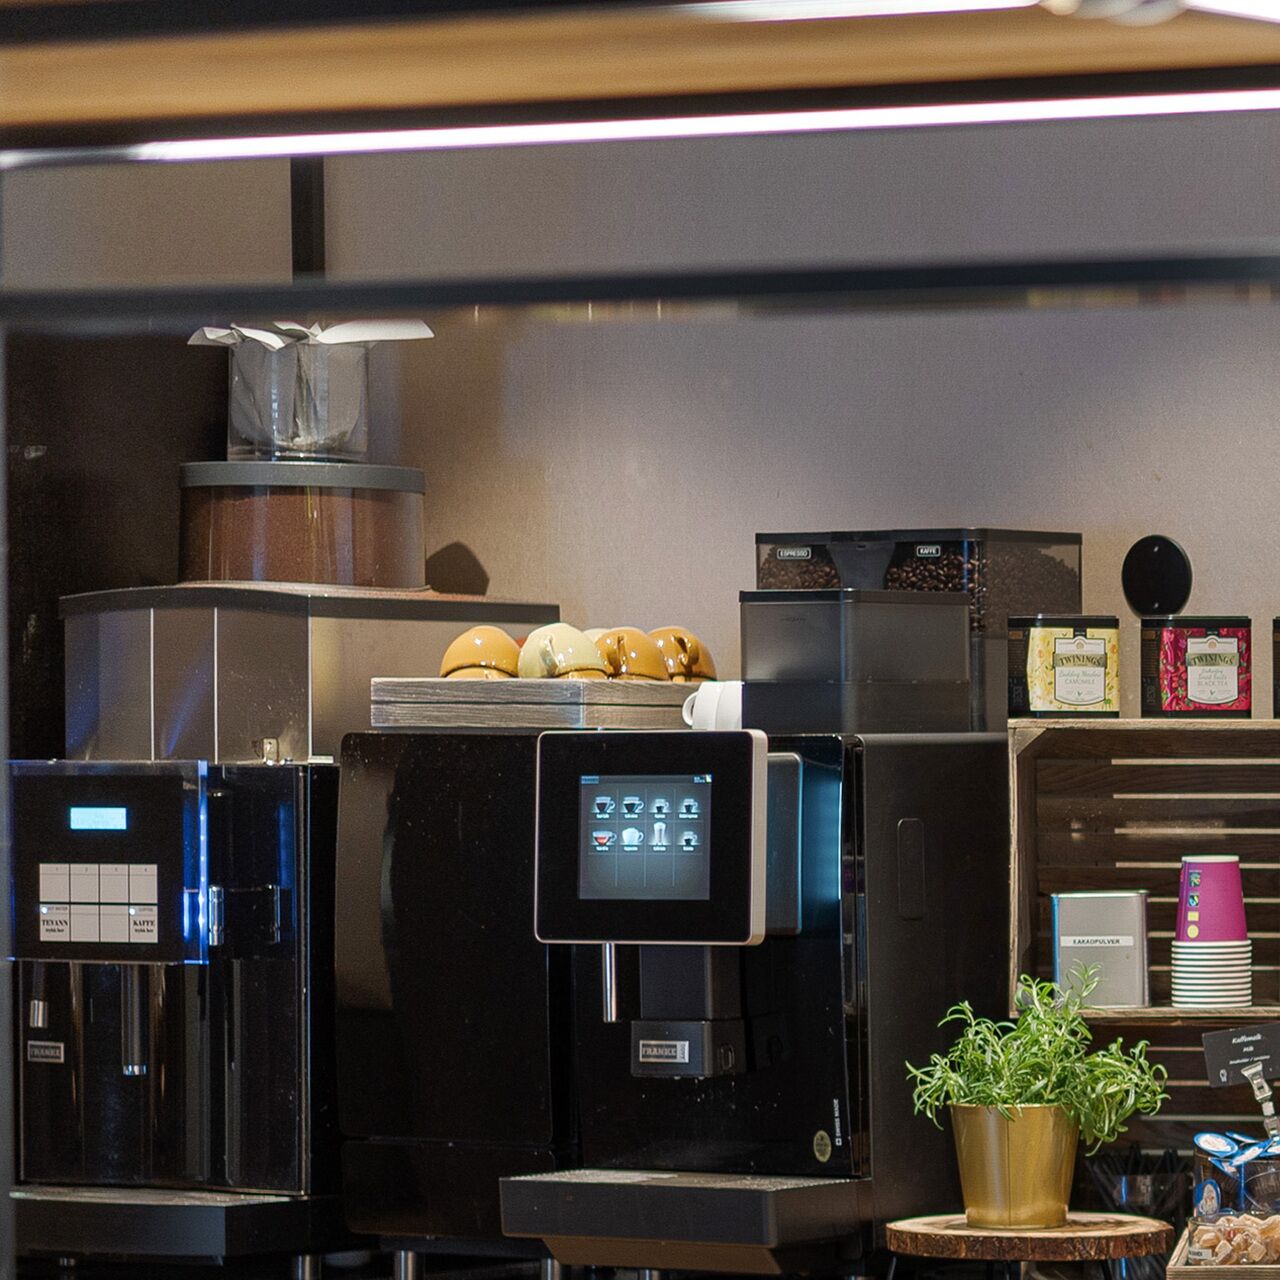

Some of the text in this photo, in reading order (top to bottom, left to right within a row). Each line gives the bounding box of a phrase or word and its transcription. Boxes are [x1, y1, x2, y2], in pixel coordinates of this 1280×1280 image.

[1060, 654, 1104, 667] TWININGS
[1191, 654, 1236, 667] TWININGS
[642, 1047, 677, 1056] FRANKE
